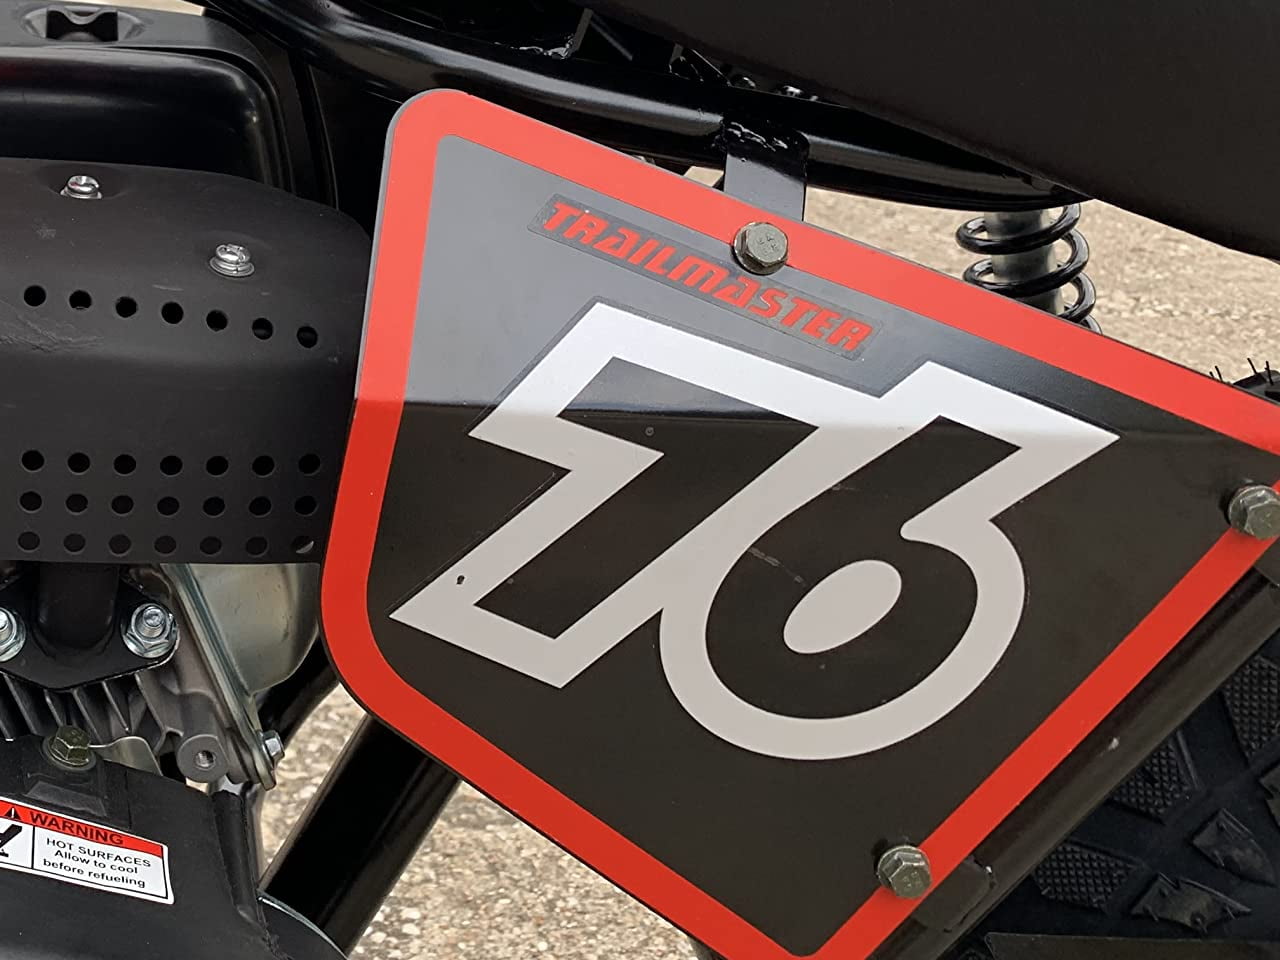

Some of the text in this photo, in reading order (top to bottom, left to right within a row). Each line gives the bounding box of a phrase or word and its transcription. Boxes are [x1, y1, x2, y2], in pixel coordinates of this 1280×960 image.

[543, 201, 873, 351] TRAILMASTER
[30, 811, 123, 845] WARNING
[46, 837, 151, 867] HOT SURFACES
[54, 849, 138, 874] Allow to cool
[43, 858, 146, 889] before refueling
